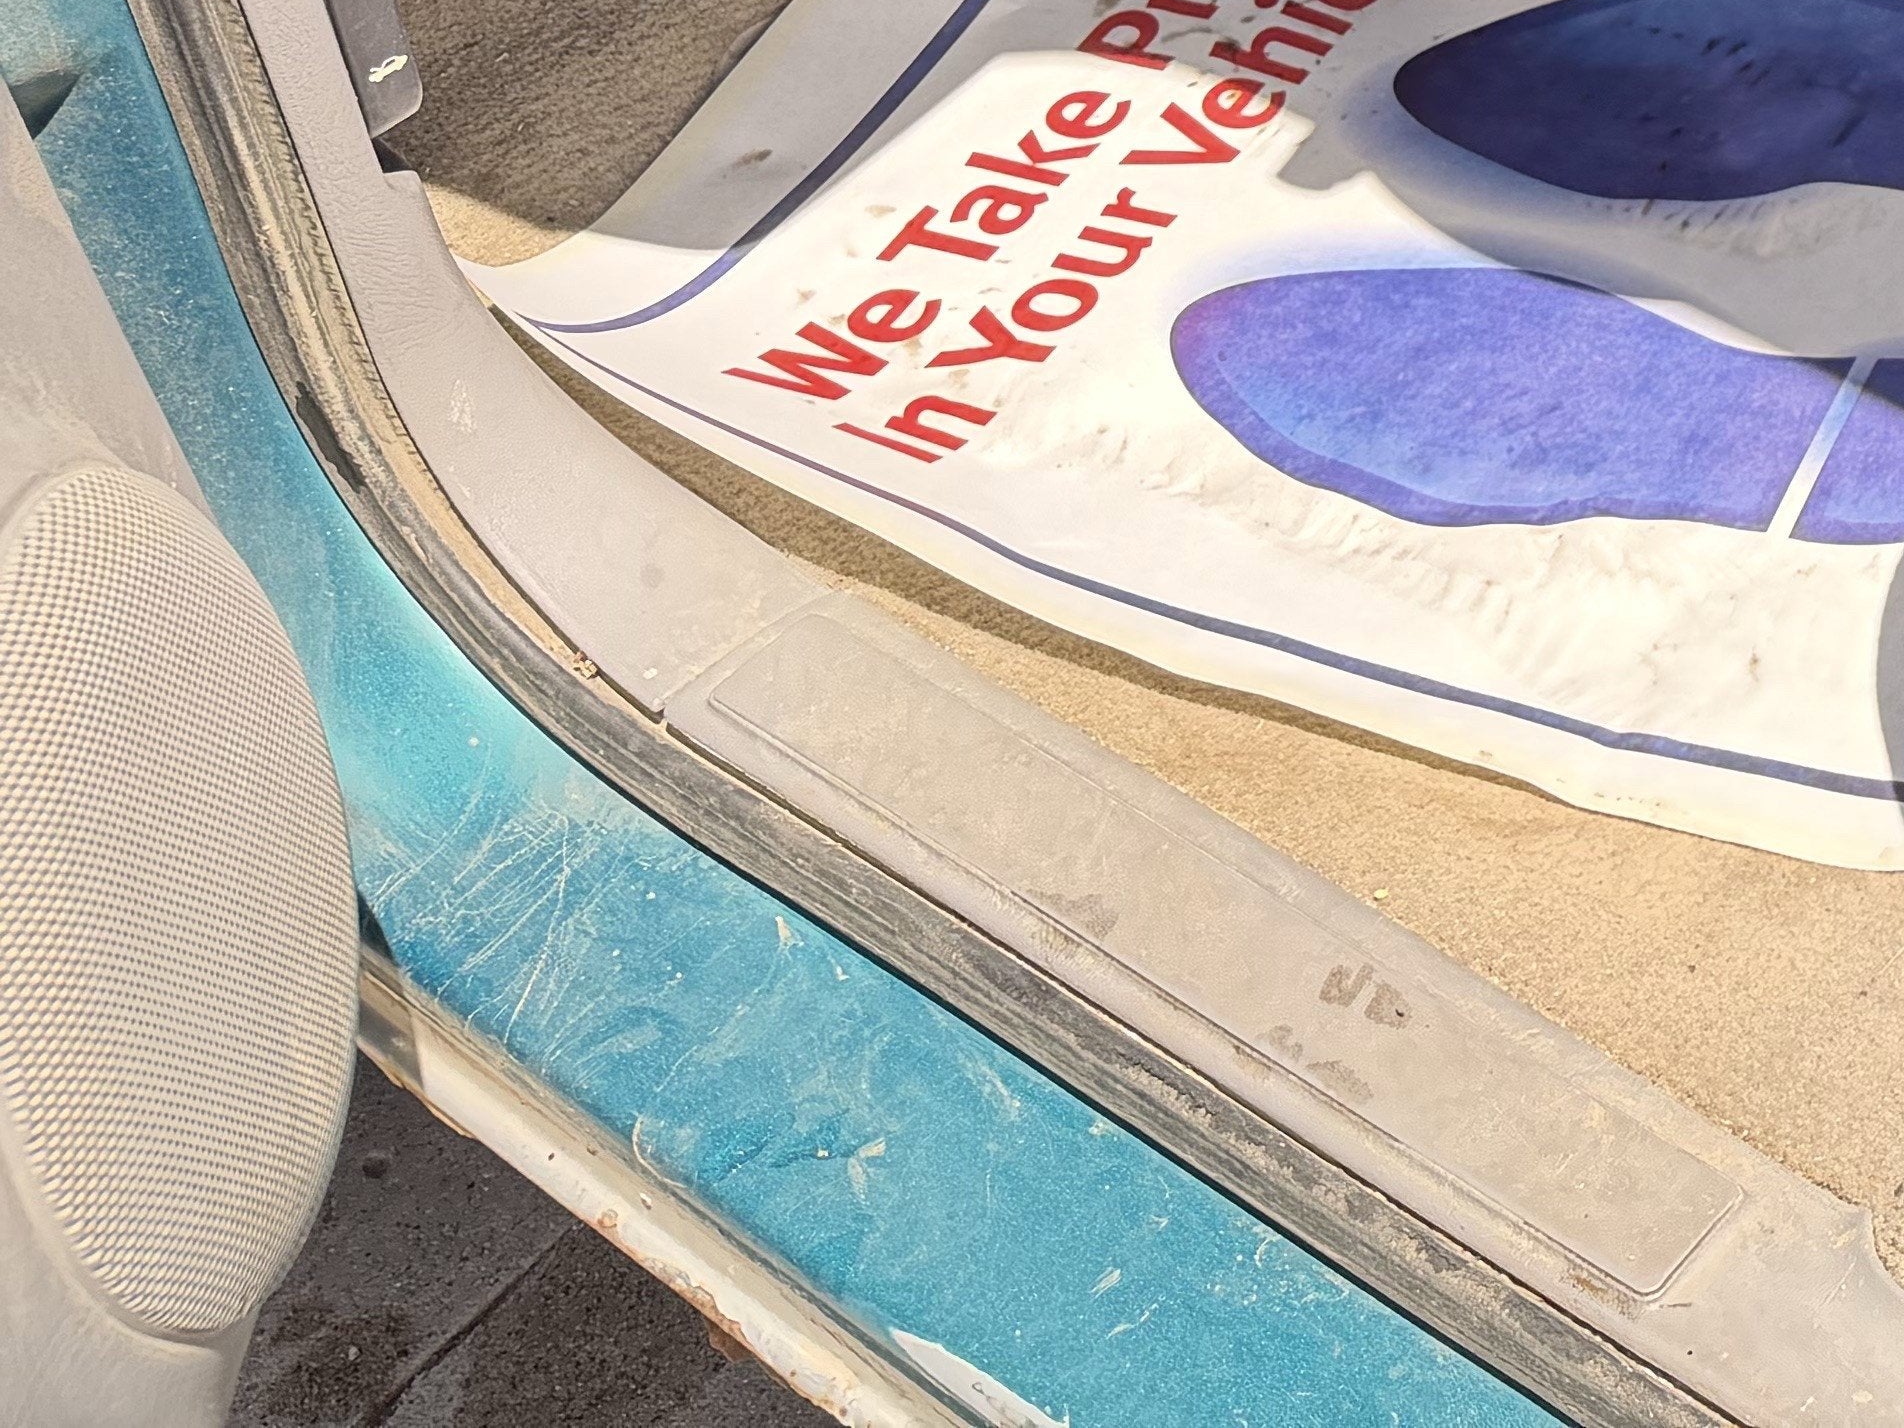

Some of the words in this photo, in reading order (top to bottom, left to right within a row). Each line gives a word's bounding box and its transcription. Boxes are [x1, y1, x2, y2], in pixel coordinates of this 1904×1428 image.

[721, 288, 943, 402] We
[876, 89, 1131, 262] Take
[833, 394, 998, 464] In
[924, 187, 1178, 369] Your
